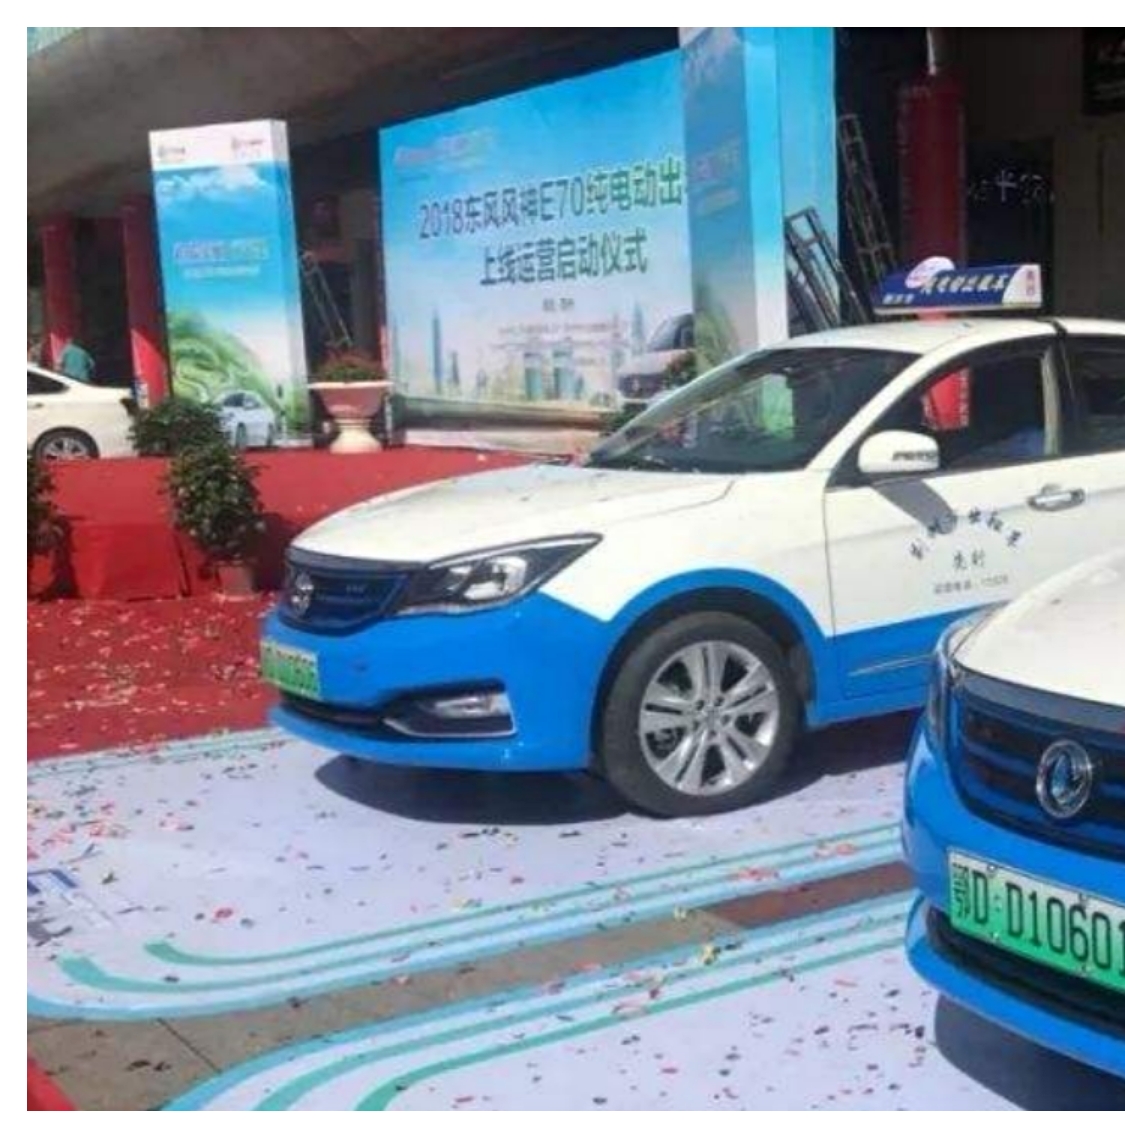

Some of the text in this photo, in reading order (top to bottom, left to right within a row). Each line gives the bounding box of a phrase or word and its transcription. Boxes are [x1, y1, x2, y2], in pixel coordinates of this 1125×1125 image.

[480, 227, 648, 286] 上线运营启动仪式
